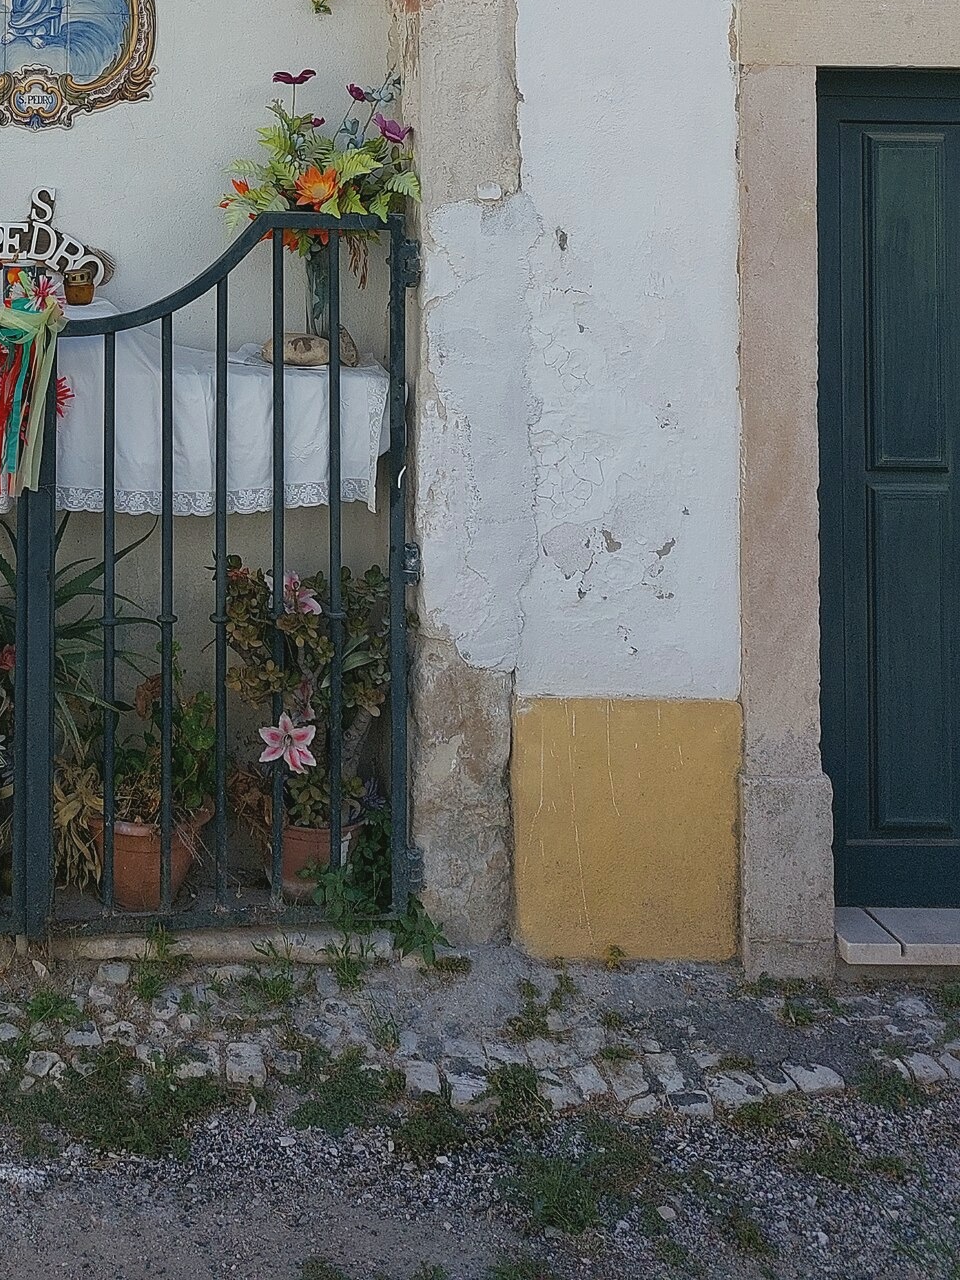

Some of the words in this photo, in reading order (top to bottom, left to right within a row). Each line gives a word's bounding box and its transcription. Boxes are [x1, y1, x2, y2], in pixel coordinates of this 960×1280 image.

[18, 95, 27, 105] S.
[27, 95, 54, 105] PEDRO
[30, 185, 56, 222] S
